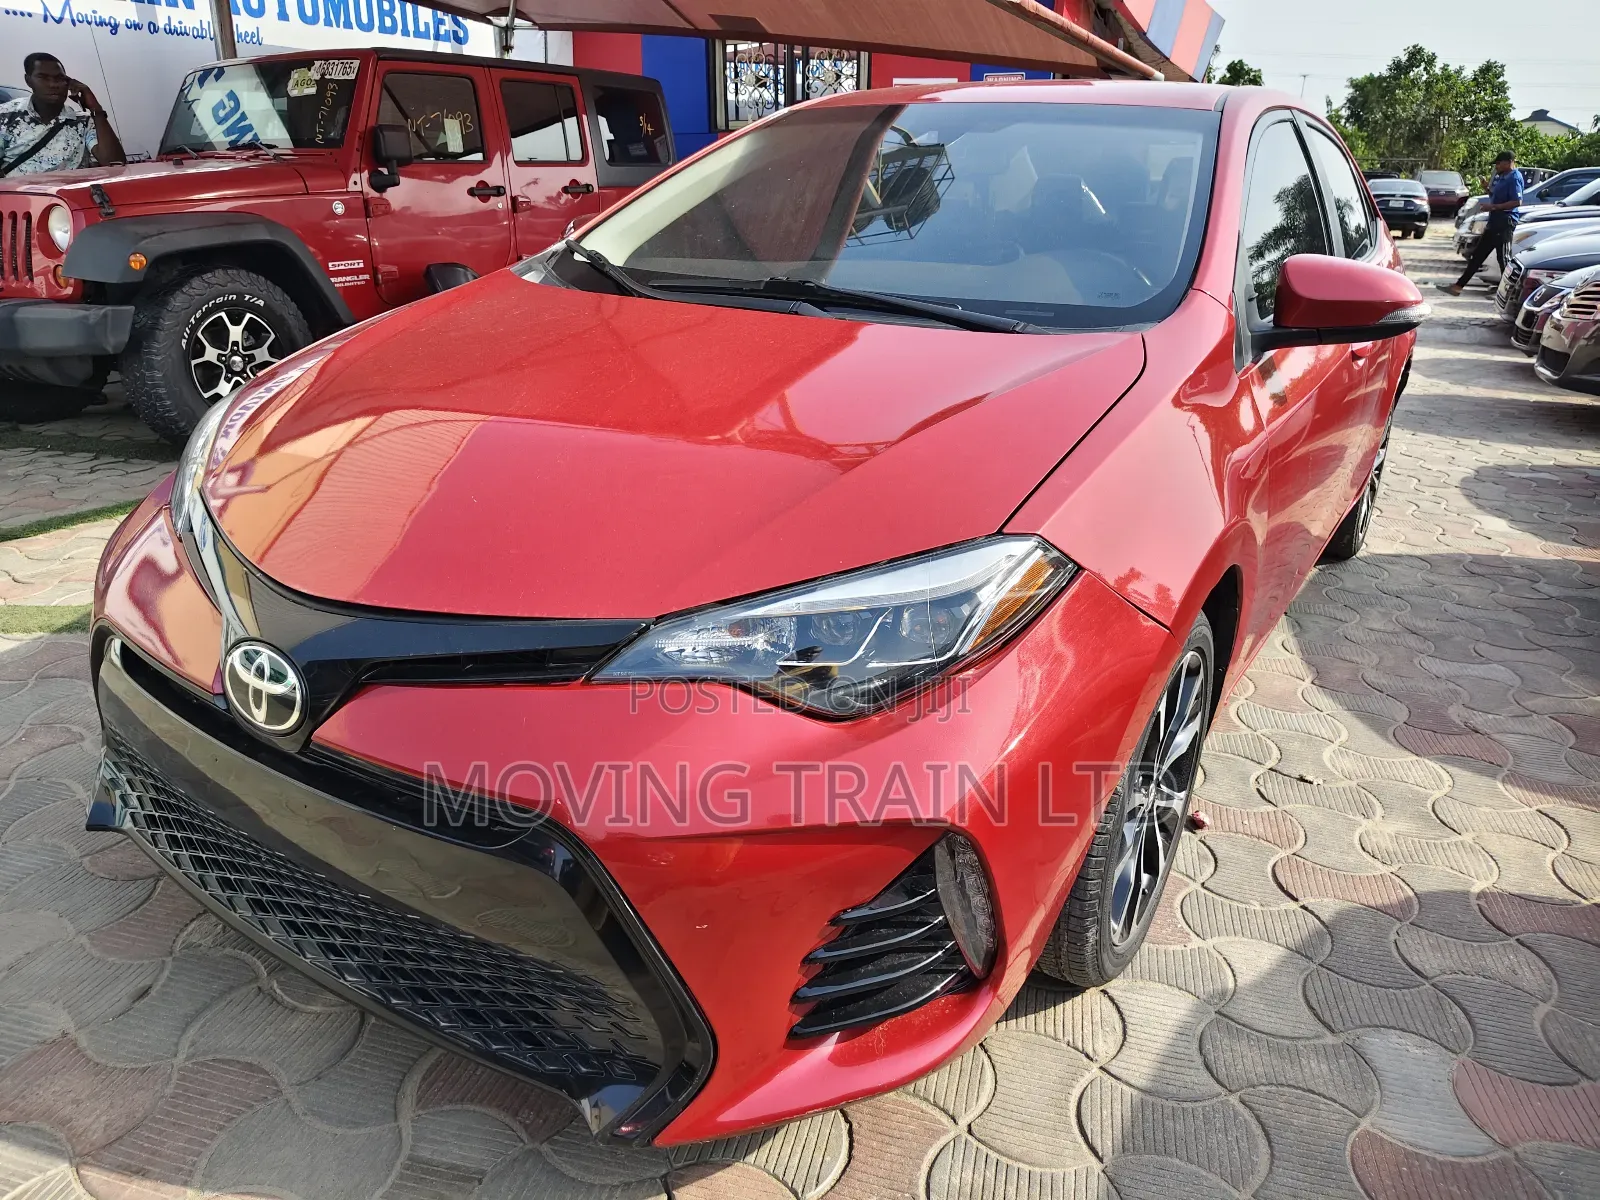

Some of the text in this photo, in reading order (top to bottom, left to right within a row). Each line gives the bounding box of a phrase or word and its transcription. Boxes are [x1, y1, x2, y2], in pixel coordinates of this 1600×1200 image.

[41, 0, 120, 35] Moving
[124, 18, 143, 31] on
[147, 21, 160, 35] a
[163, 15, 216, 41] drivabl
[233, 23, 263, 46] heel
[230, 0, 469, 46] OMOBILES
[330, 261, 361, 269] SPORT
[181, 294, 266, 351] All-Terrain T/A
